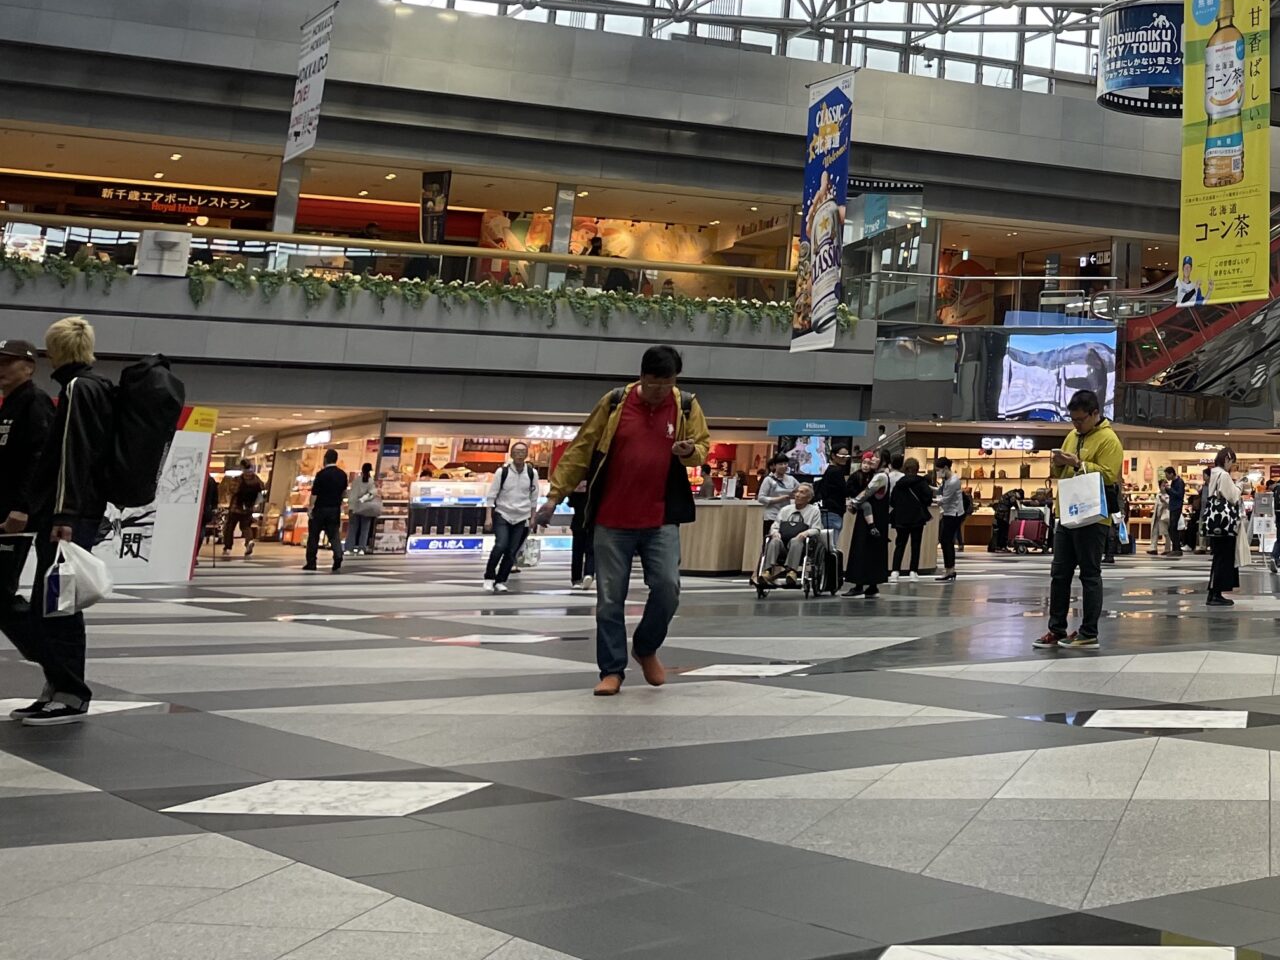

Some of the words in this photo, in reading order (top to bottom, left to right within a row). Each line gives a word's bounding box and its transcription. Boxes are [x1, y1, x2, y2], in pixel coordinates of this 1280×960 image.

[1106, 29, 1172, 48] SNOWMIKU
[1207, 67, 1242, 90] コーン茶
[101, 188, 251, 209] 新千歳エアポートレストラン
[152, 202, 177, 213] Royal
[178, 203, 199, 213] Host
[1209, 203, 1237, 217] 北海道
[1195, 214, 1250, 242] コーン茶
